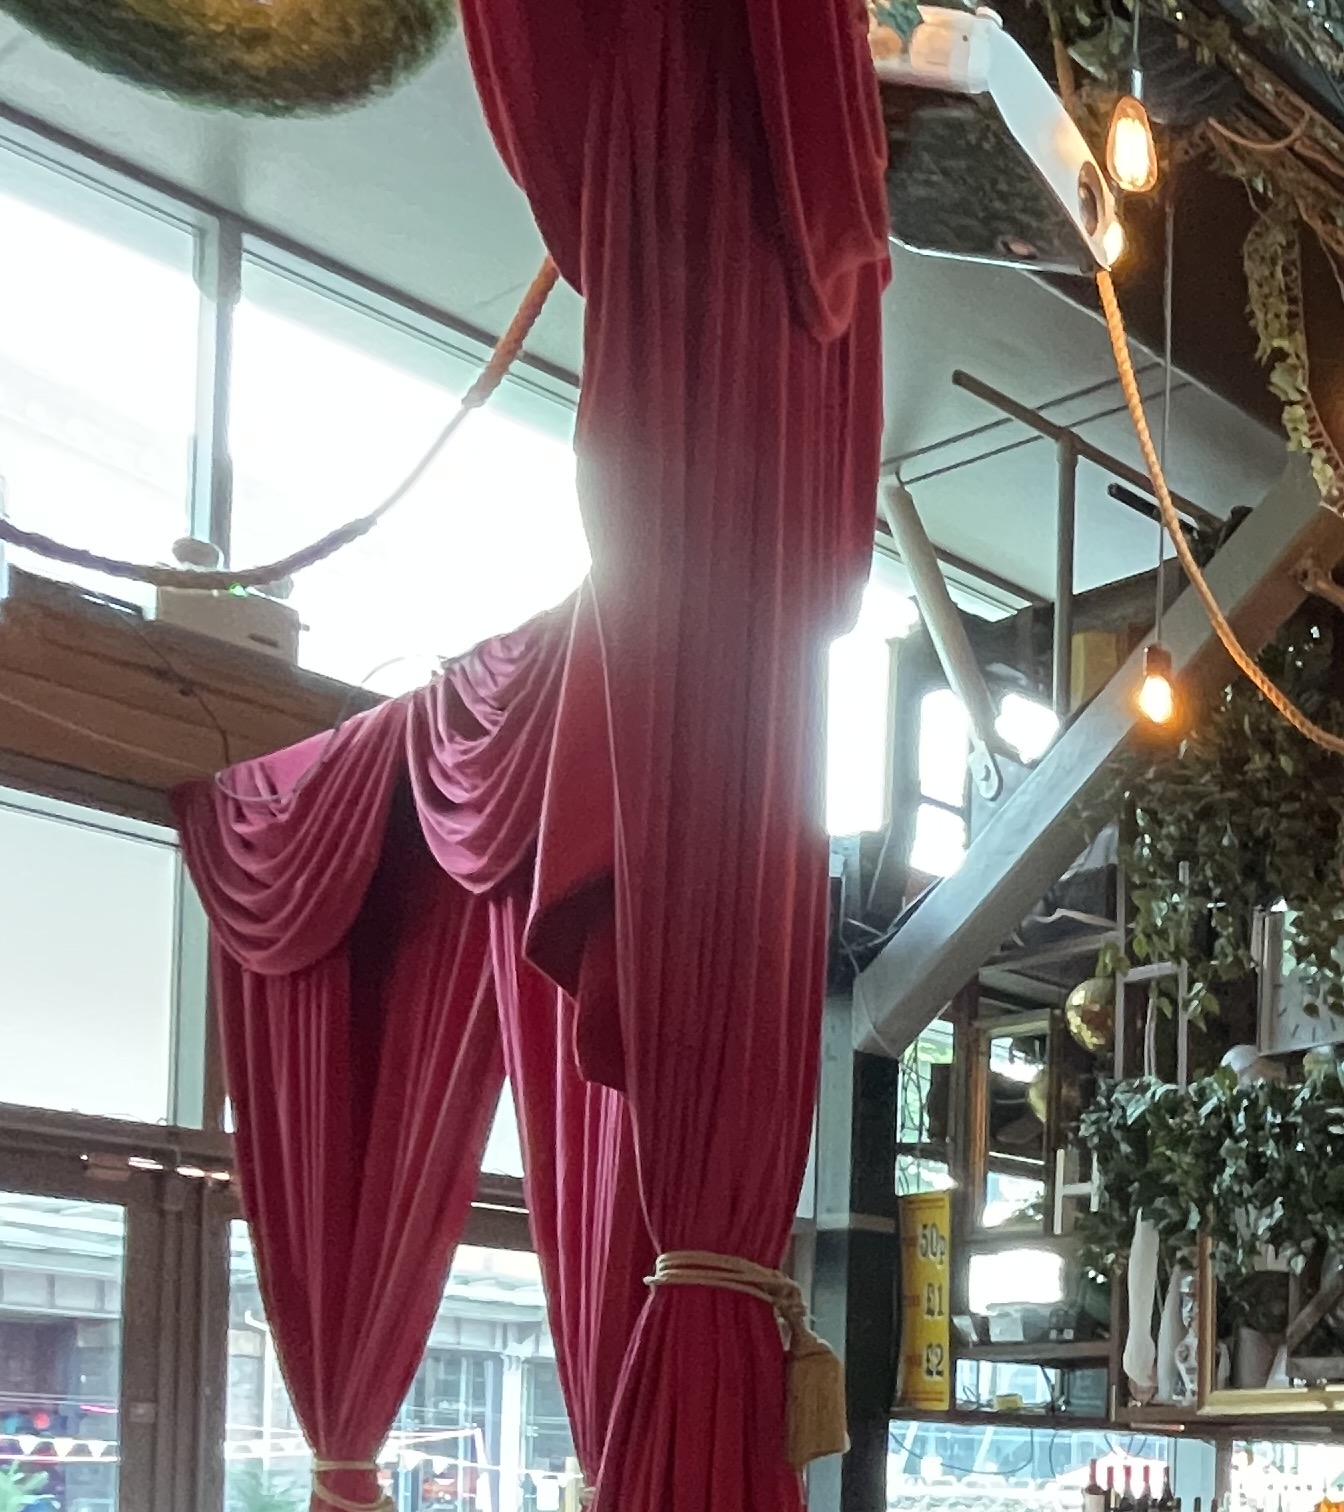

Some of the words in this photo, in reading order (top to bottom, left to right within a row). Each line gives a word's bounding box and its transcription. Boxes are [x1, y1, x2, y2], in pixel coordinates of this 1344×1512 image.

[919, 1222, 946, 1266] 50p
[926, 1282, 944, 1317] £1
[925, 1343, 944, 1378] £2
